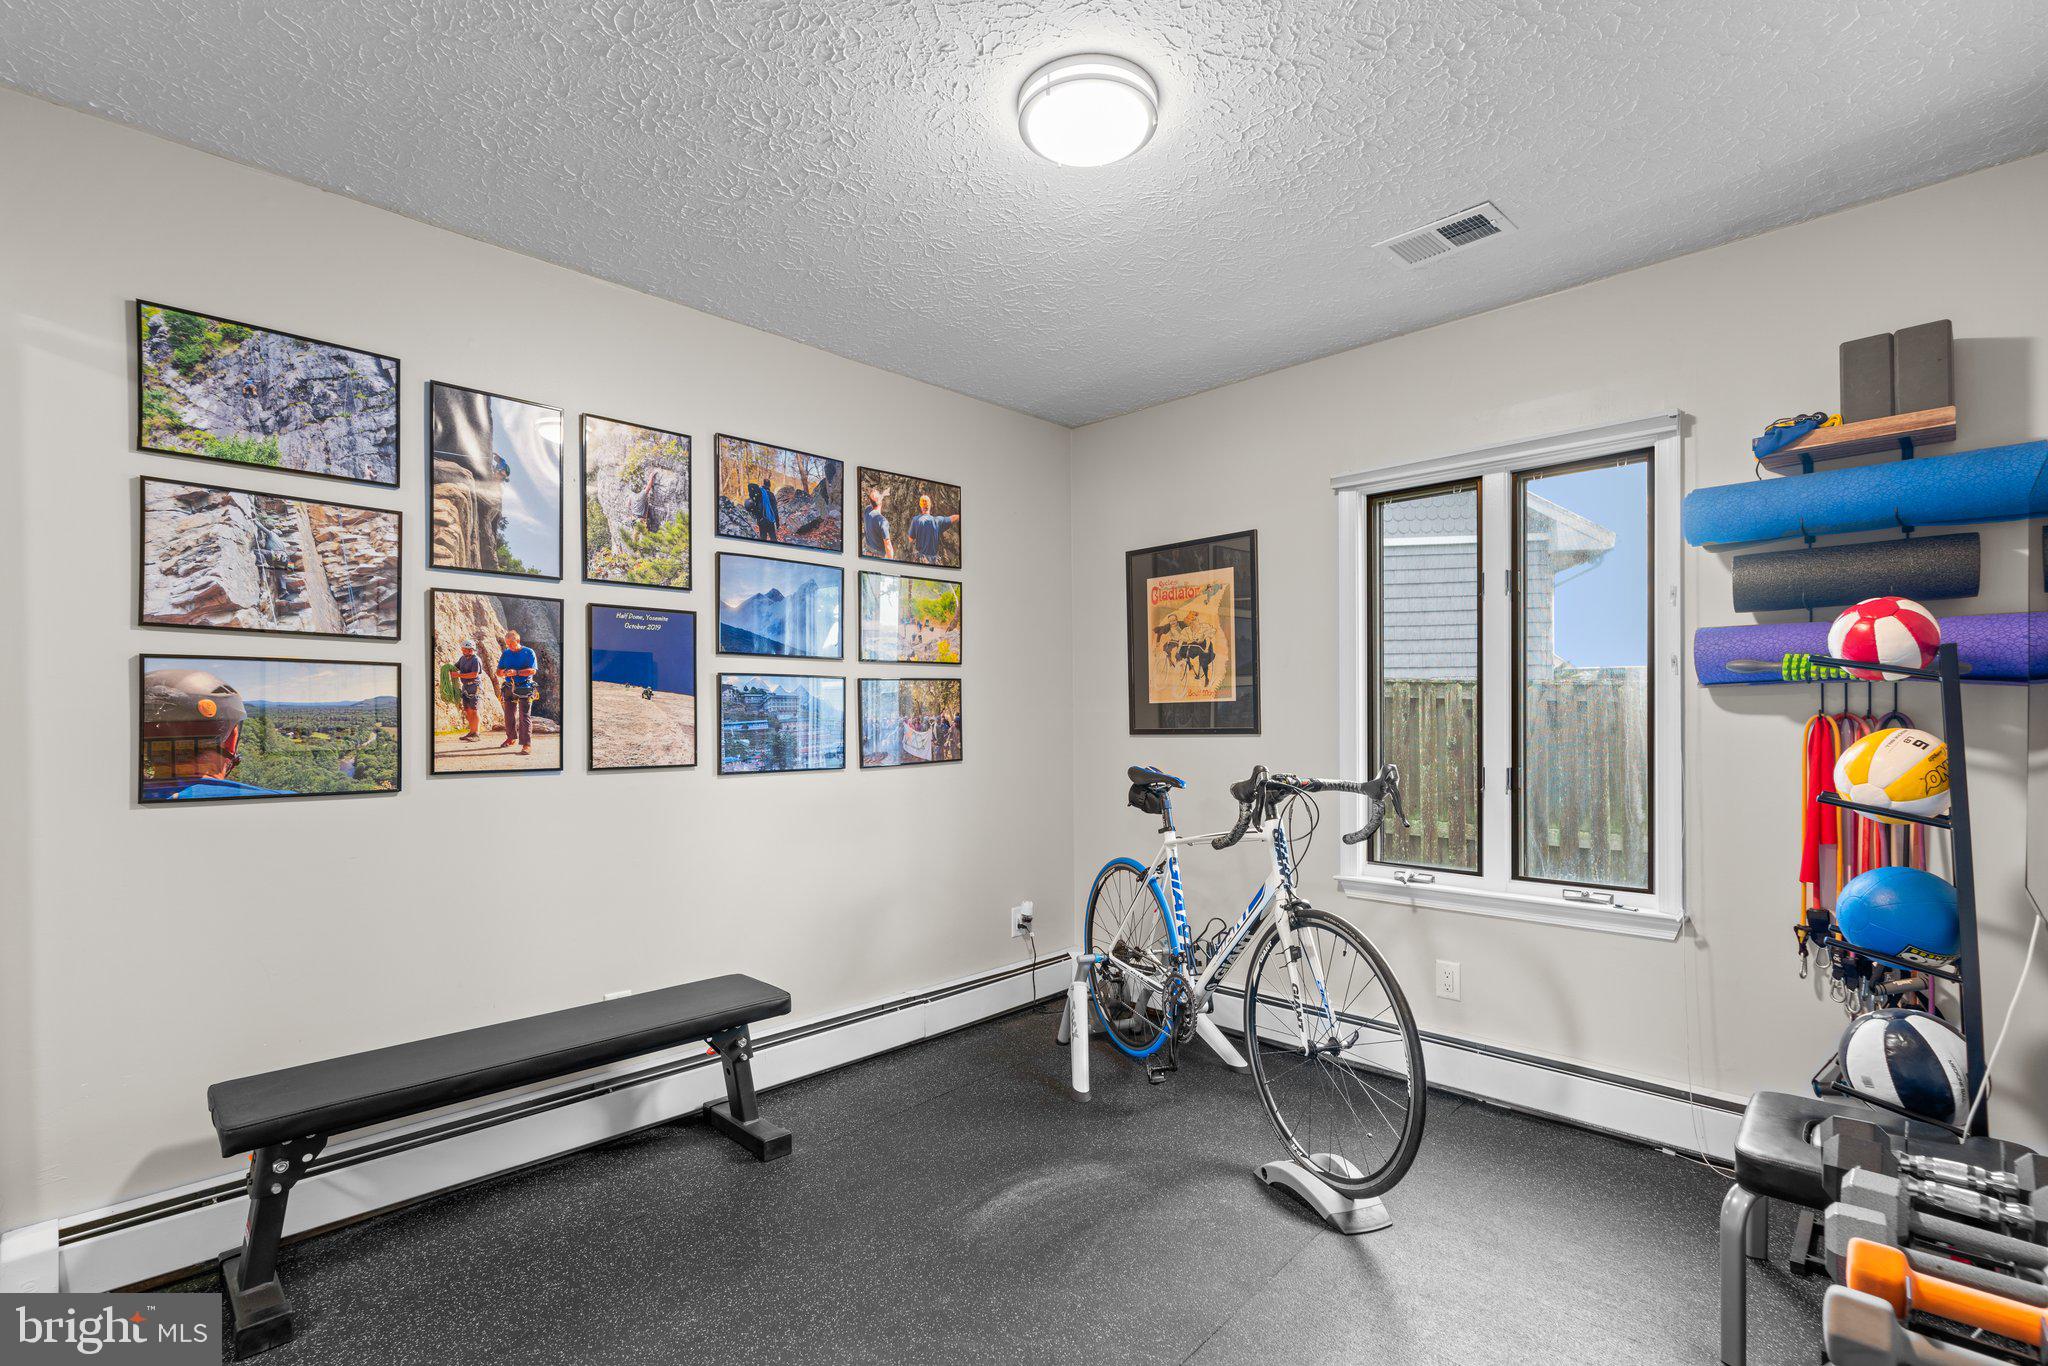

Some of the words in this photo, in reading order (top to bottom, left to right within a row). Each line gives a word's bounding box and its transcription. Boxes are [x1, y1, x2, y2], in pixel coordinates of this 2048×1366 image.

[1151, 586, 1200, 605] Gladiator
[616, 612, 629, 620] Half
[629, 612, 645, 621] Dome,
[645, 614, 669, 622] Yosemite
[624, 622, 647, 631] October
[1212, 929, 1255, 982] GIANT
[1258, 940, 1272, 963] GIANT
[1292, 983, 1304, 1033] GIANT
